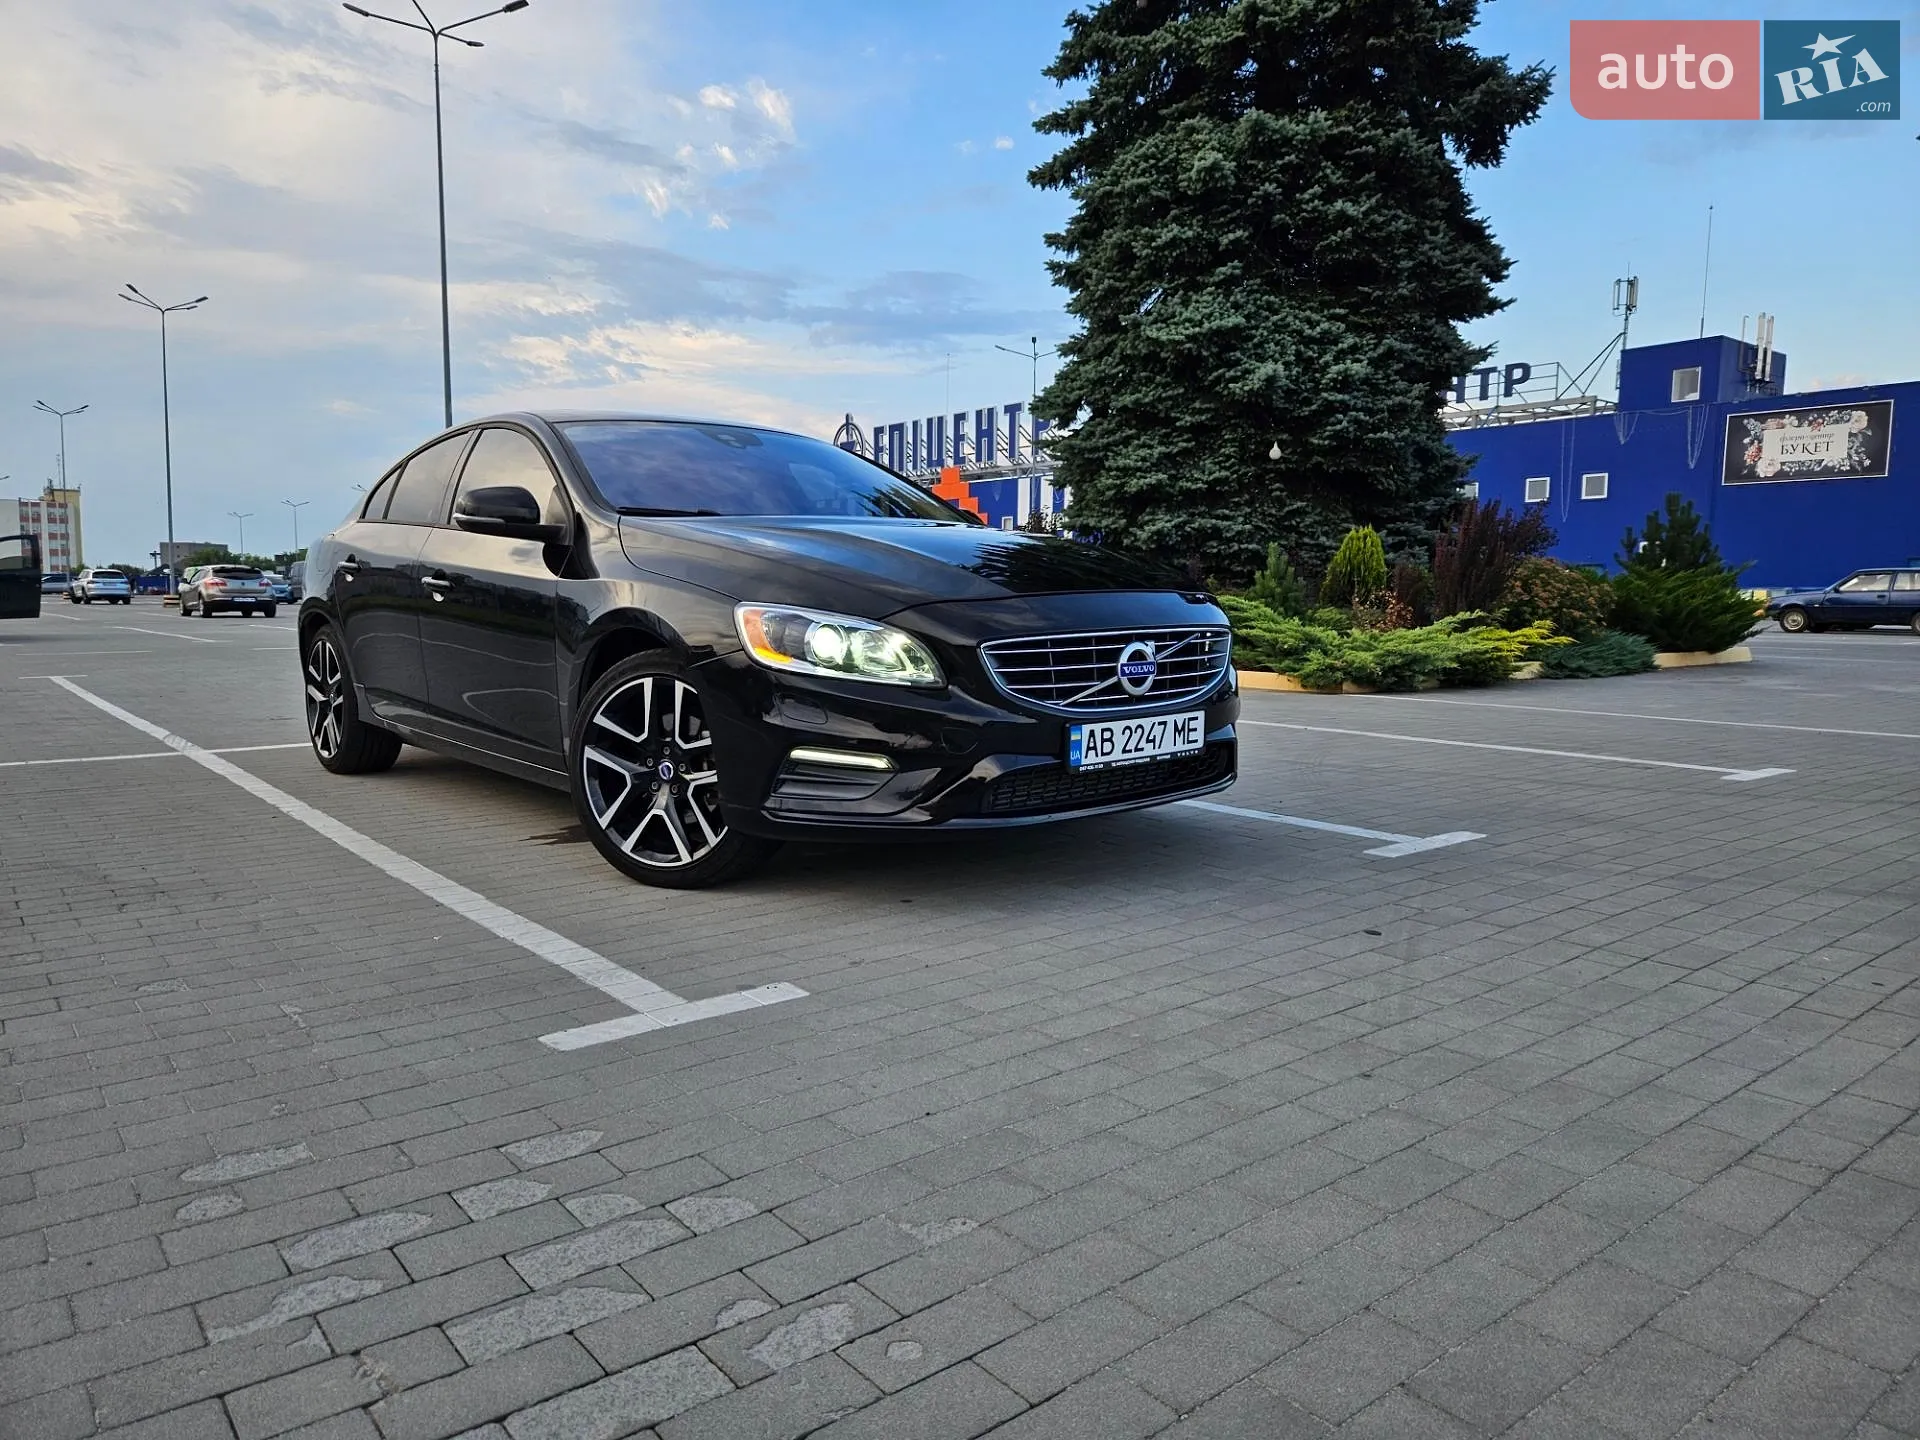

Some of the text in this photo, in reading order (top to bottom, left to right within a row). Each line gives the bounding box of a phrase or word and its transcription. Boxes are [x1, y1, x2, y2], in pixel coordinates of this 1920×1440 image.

[1781, 441, 1835, 456] БУКЕТ
[1123, 665, 1154, 674] VOLVO
[1084, 716, 1199, 760] AB 2247 ME
[1070, 751, 1081, 761] UA
